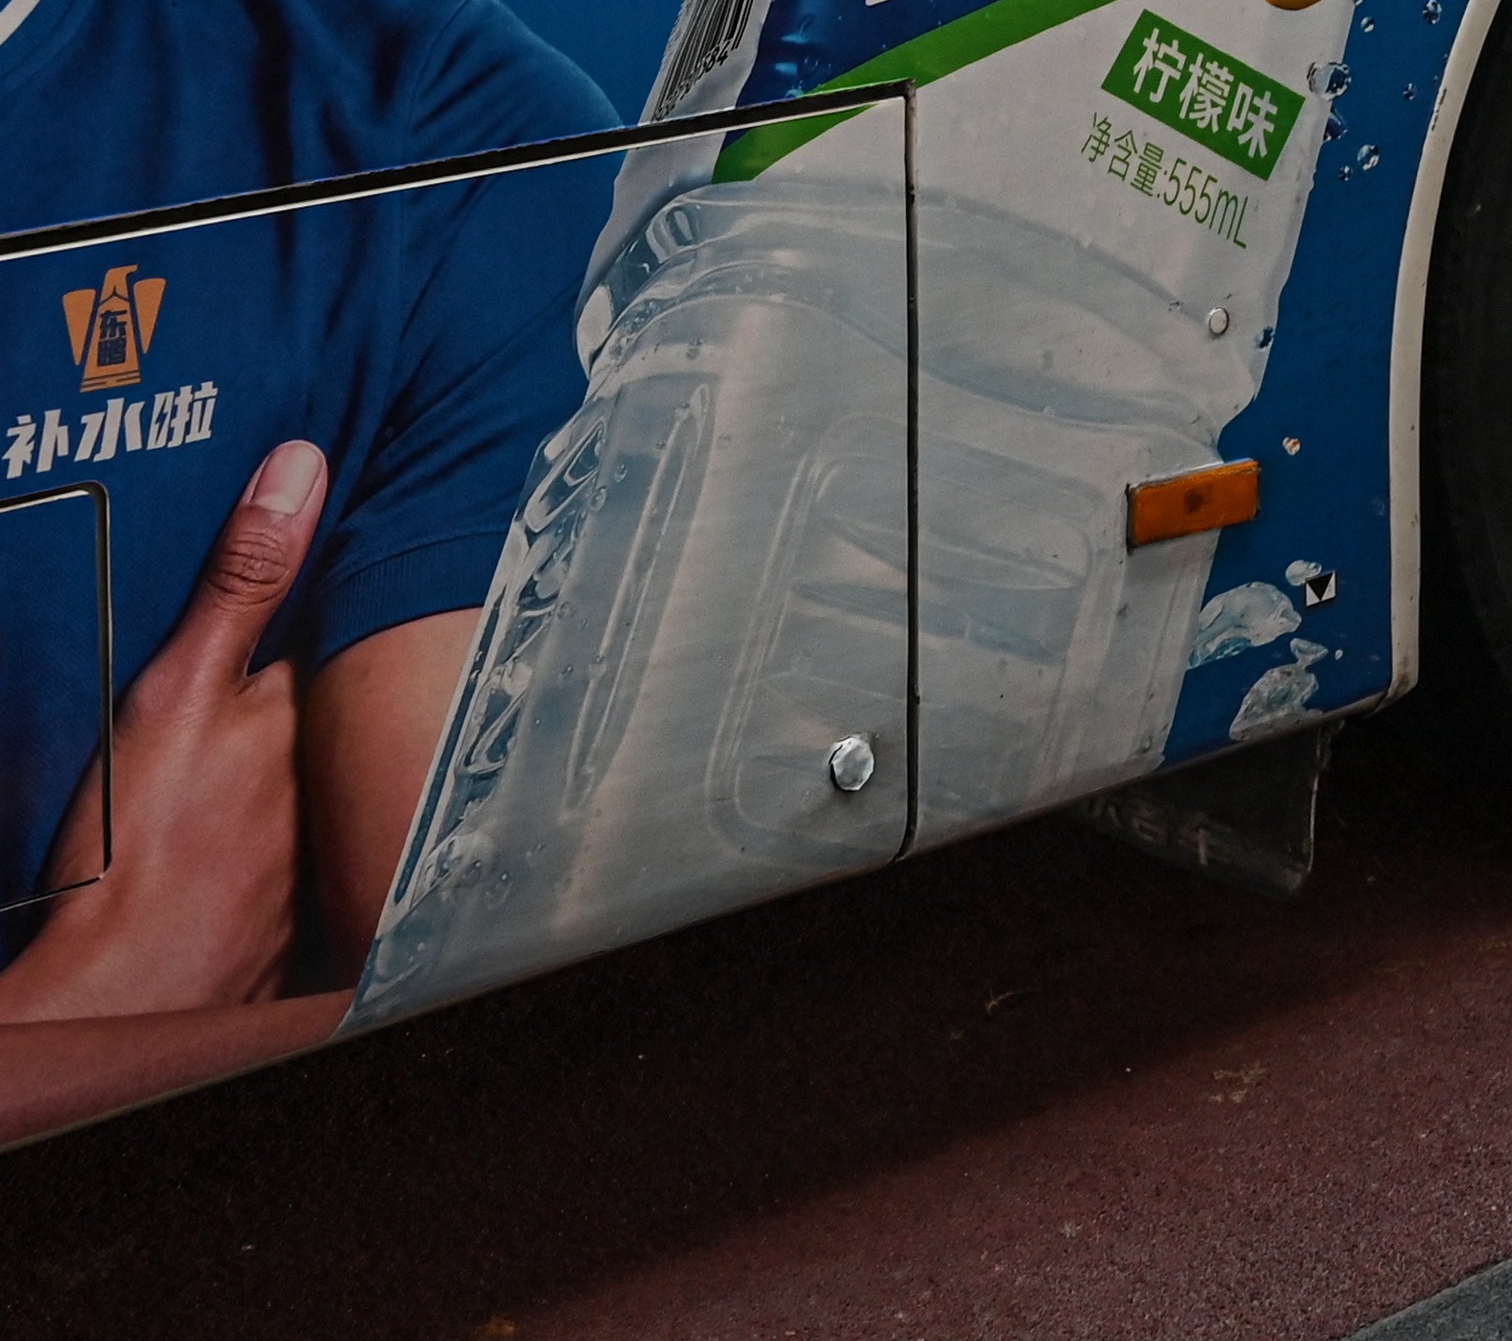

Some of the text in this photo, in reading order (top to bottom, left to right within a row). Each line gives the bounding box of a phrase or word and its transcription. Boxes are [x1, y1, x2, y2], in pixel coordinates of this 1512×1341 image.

[1133, 27, 1279, 159] 柠檬味
[1080, 111, 1249, 250] 净含量:555mL
[1, 380, 220, 480] 补水啦
